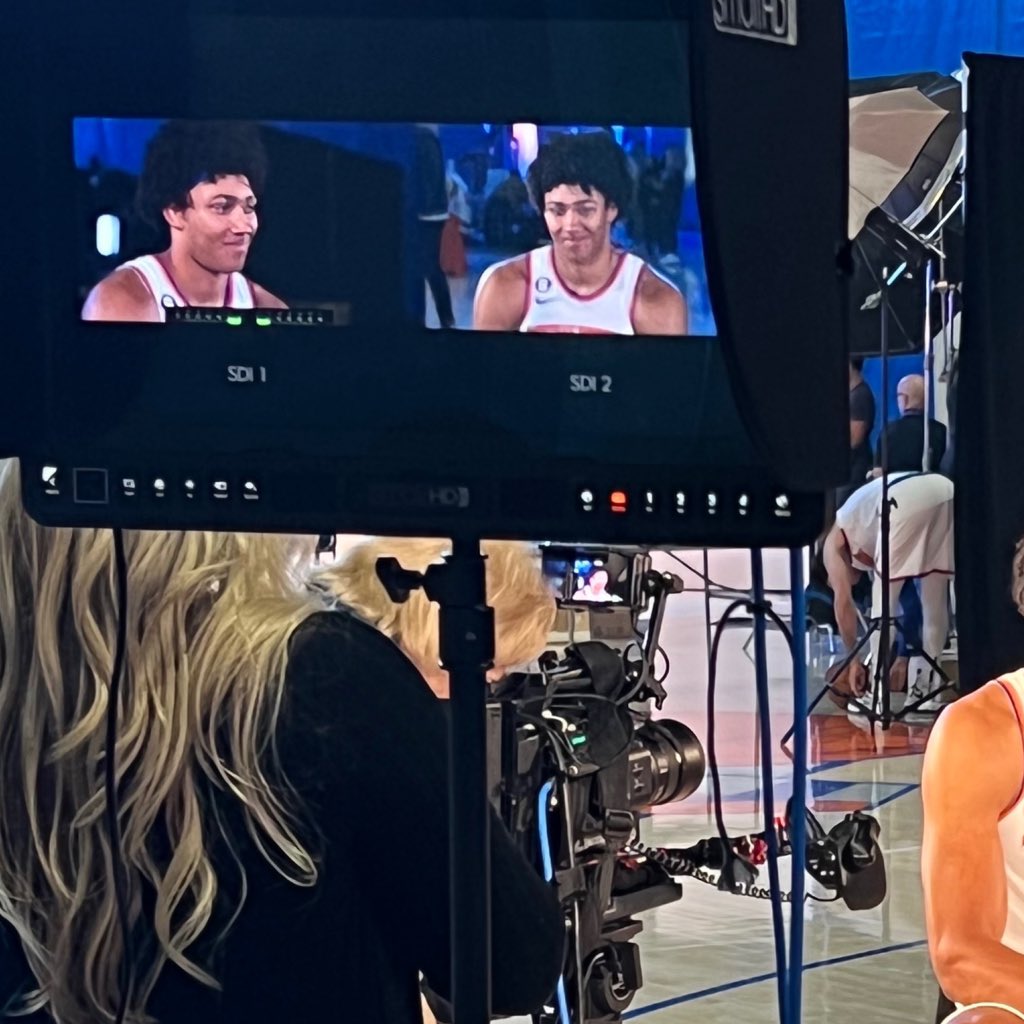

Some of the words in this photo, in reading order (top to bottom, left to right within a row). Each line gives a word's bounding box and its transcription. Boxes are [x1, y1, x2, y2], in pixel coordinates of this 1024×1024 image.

[227, 365, 254, 382] SDI
[260, 366, 266, 382] 1
[569, 374, 597, 392] SDI
[601, 374, 612, 392] 2
